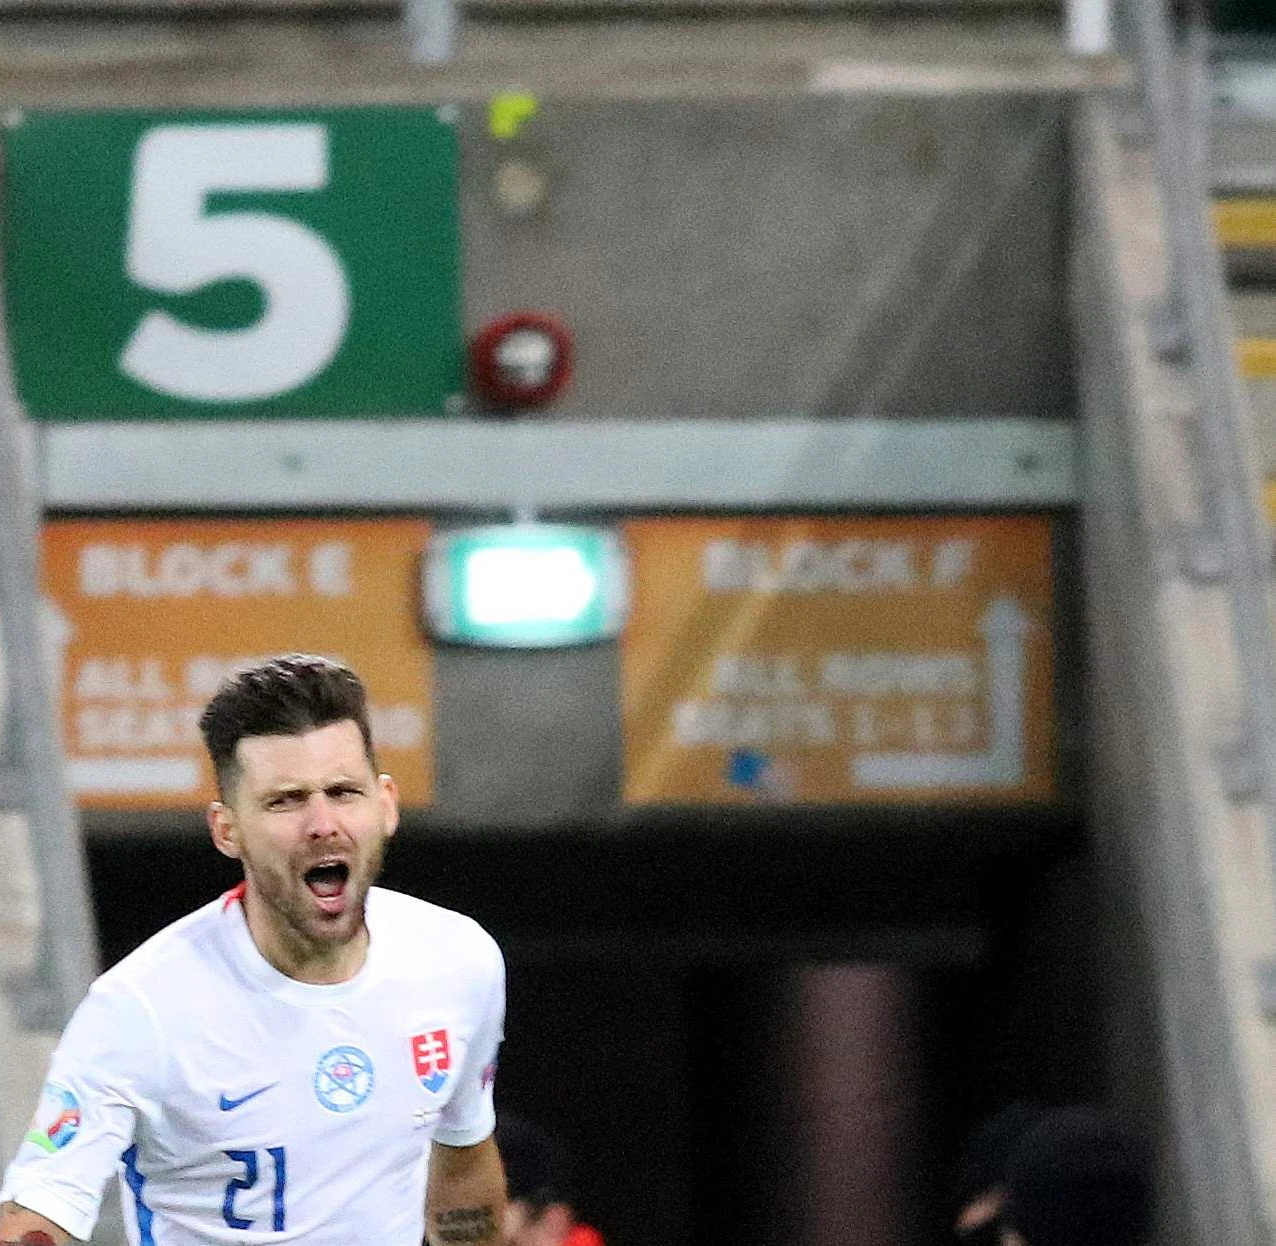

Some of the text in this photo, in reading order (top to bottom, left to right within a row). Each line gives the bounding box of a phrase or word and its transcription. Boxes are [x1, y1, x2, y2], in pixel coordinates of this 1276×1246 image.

[119, 122, 351, 402] 5
[82, 546, 294, 596] BLOCK
[700, 538, 918, 592] BLOCK
[223, 1146, 288, 1233] 21
